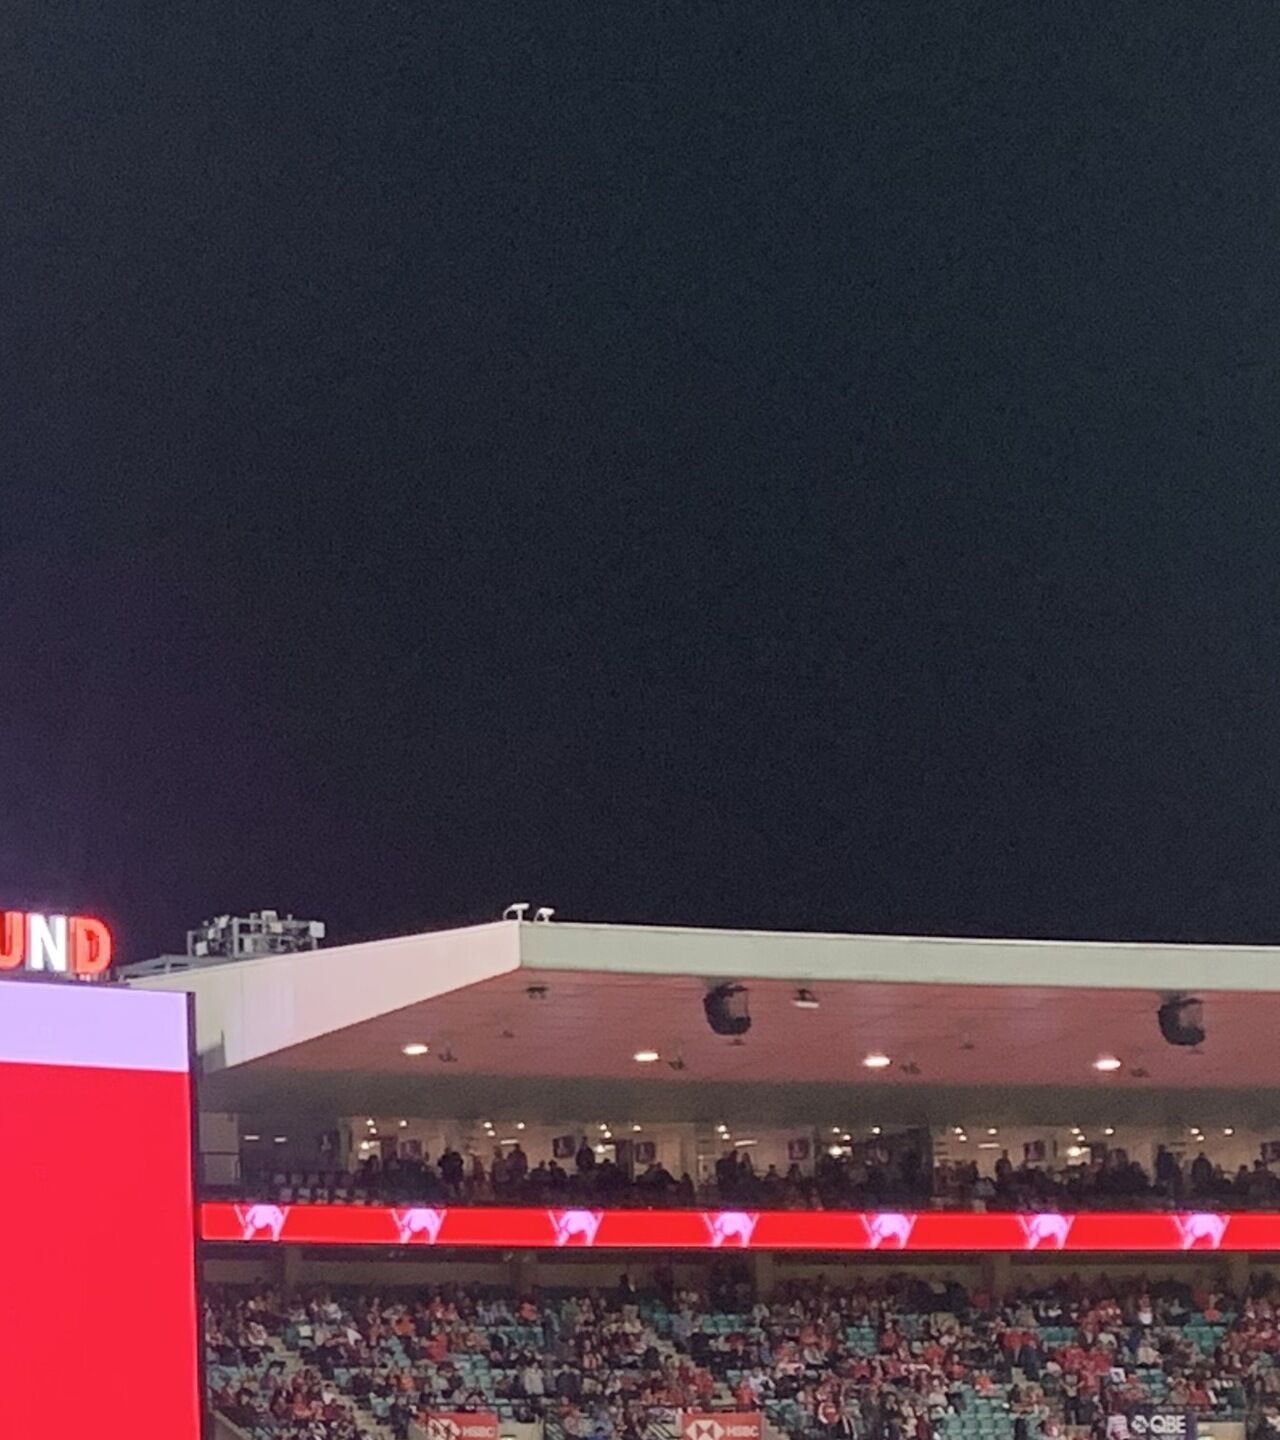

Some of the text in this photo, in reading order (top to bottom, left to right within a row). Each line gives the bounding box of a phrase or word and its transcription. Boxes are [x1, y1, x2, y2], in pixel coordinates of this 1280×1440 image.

[1150, 1415, 1187, 1434] QBE
[462, 1426, 495, 1438] HSBC
[726, 1425, 759, 1438] HSBC
